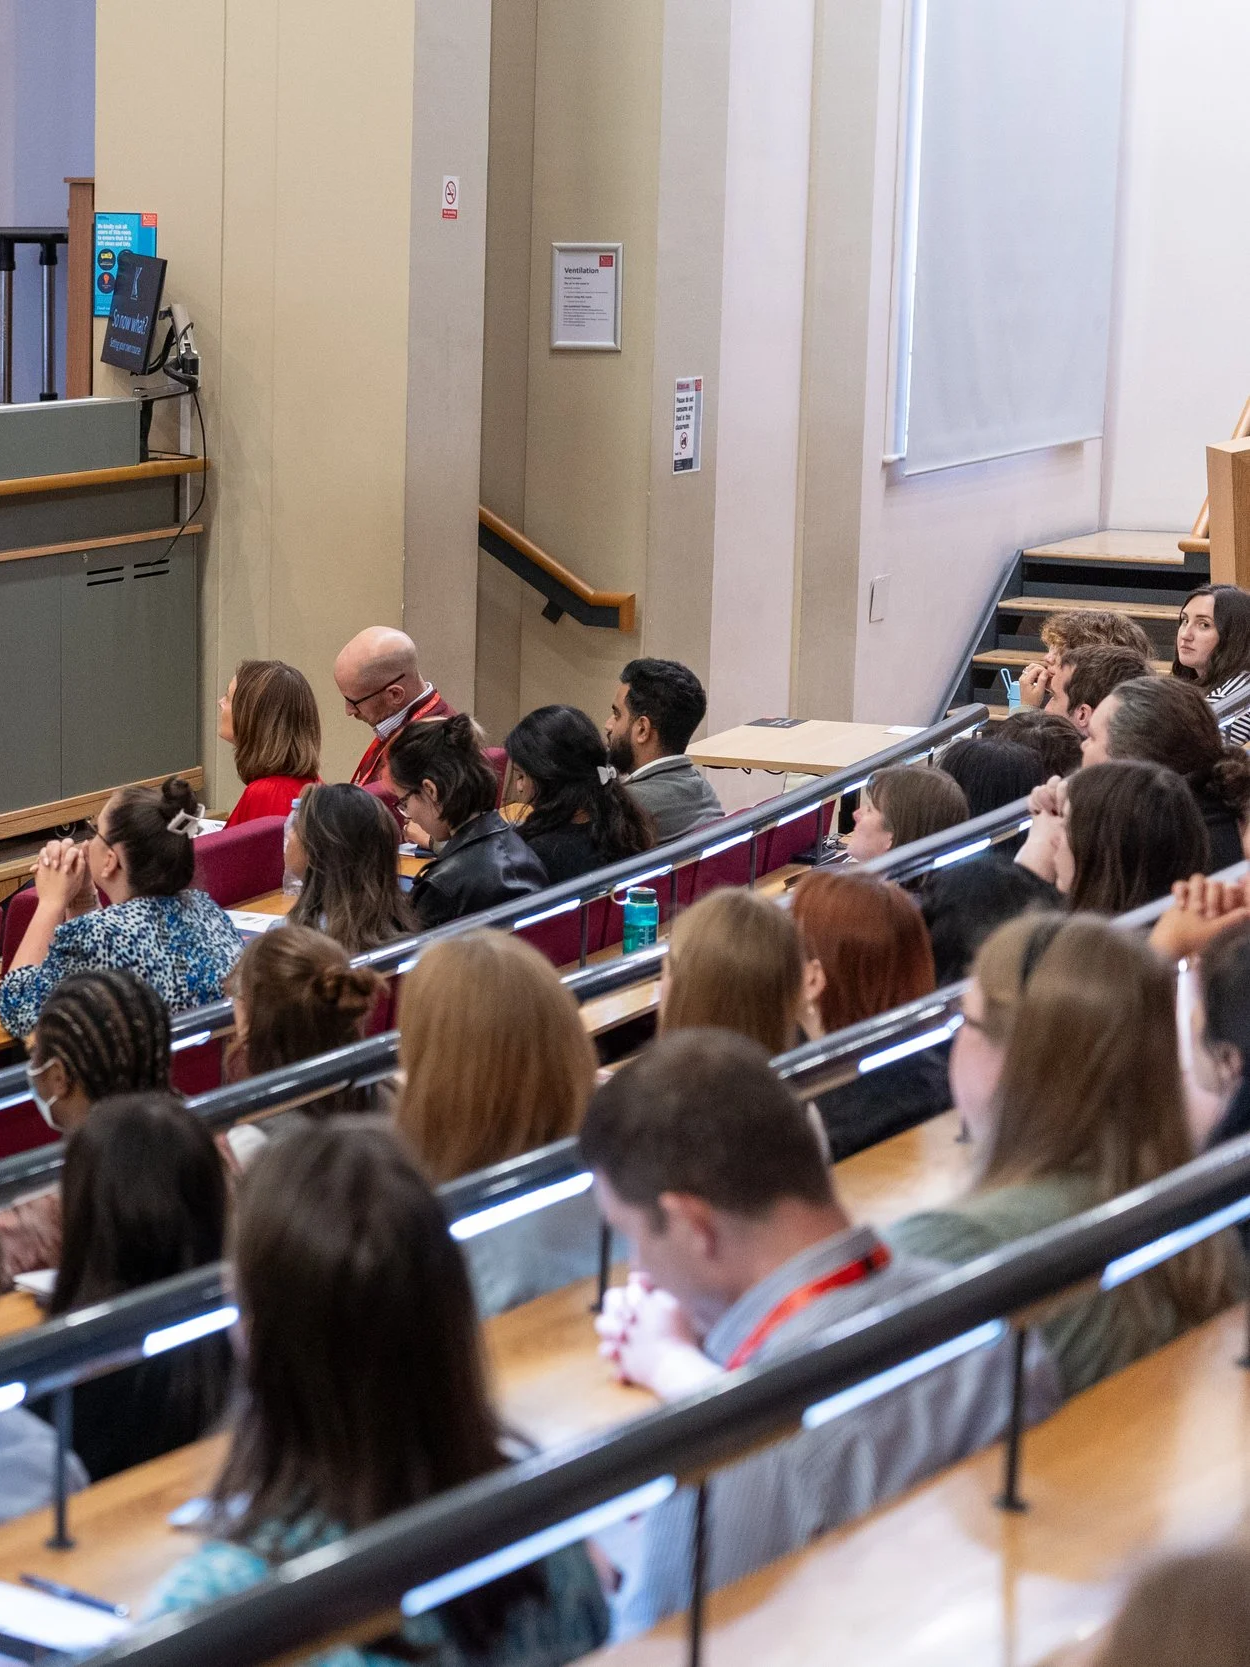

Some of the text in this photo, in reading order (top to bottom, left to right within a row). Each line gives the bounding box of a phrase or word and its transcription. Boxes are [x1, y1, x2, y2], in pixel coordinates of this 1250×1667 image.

[564, 266, 599, 274] Ventilation
[111, 308, 149, 335] So now what?
